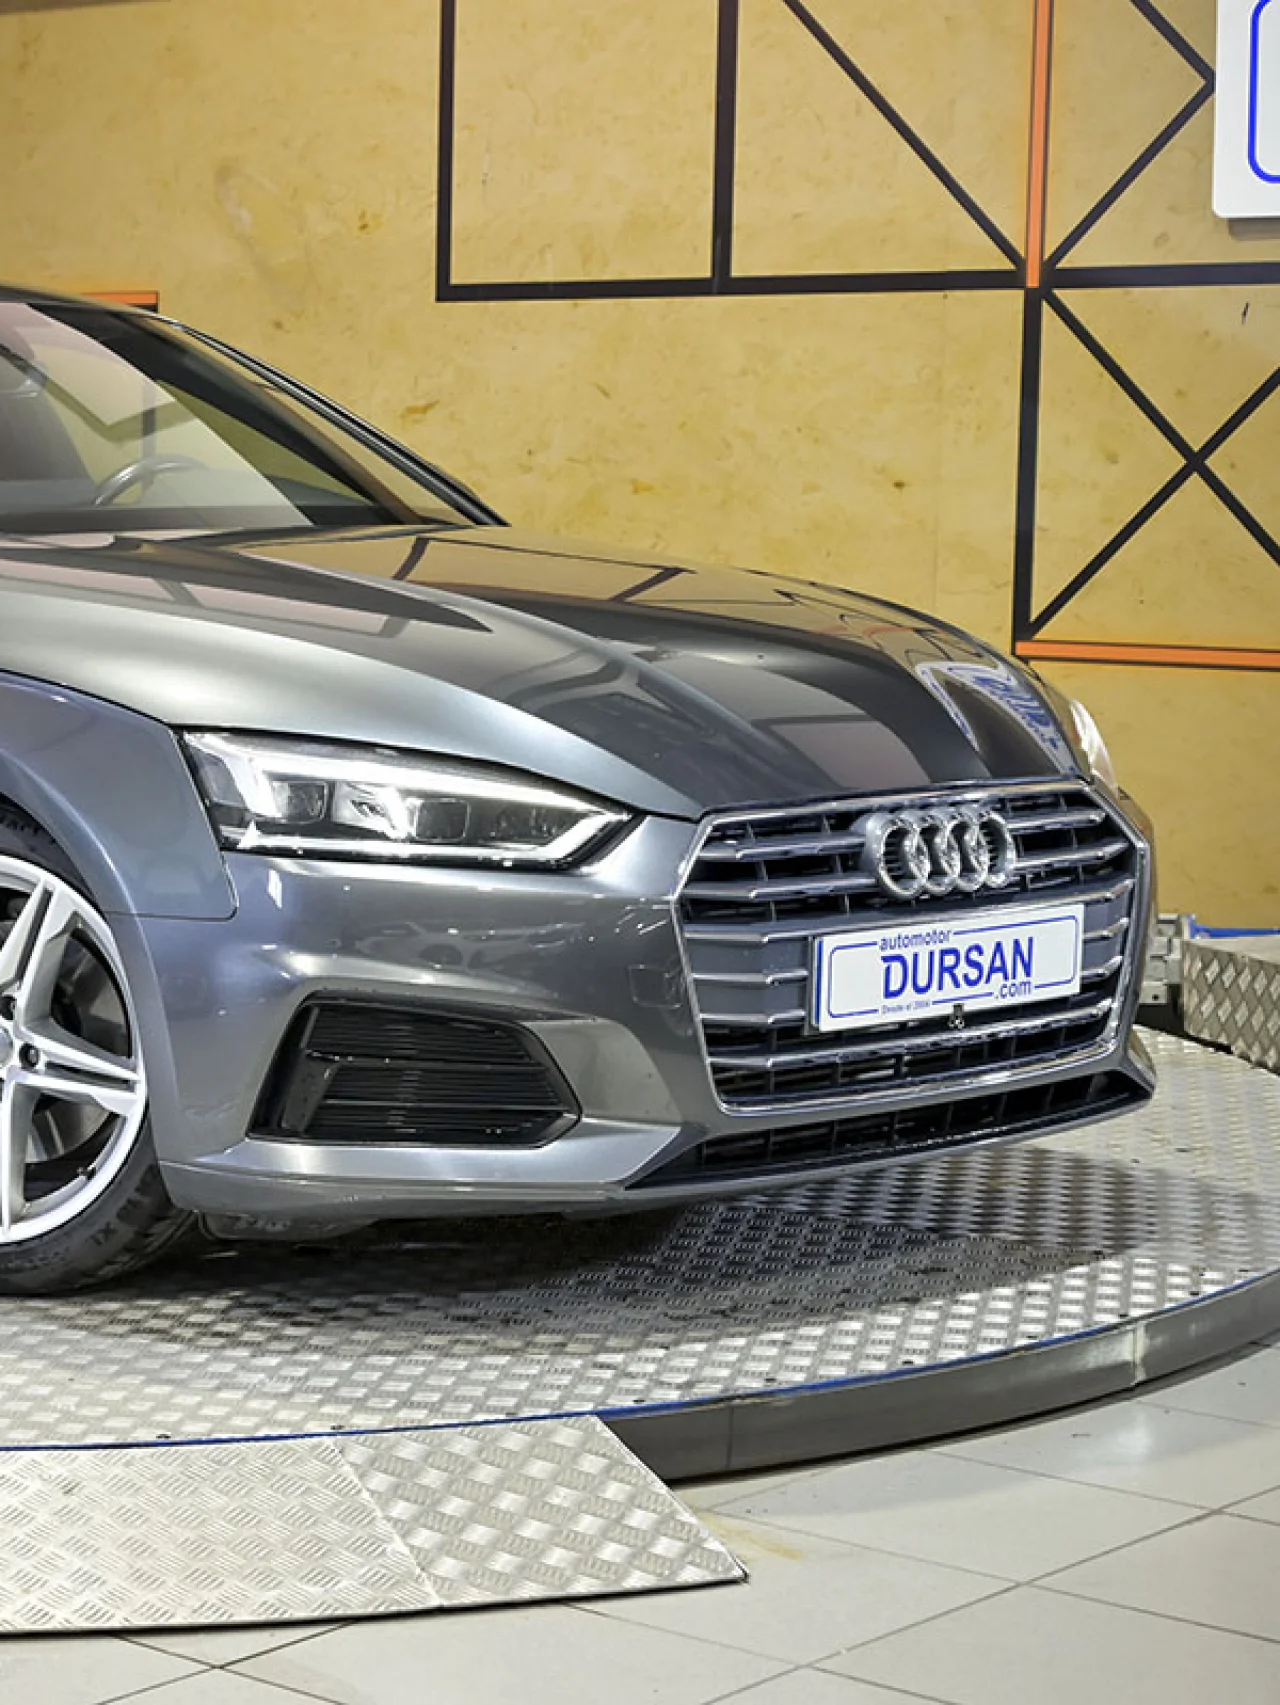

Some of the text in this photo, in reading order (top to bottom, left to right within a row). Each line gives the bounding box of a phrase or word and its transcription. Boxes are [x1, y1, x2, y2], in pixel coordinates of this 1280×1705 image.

[880, 929, 952, 951] automotor
[881, 936, 1034, 999] DURSAN
[995, 981, 1032, 999] .com
